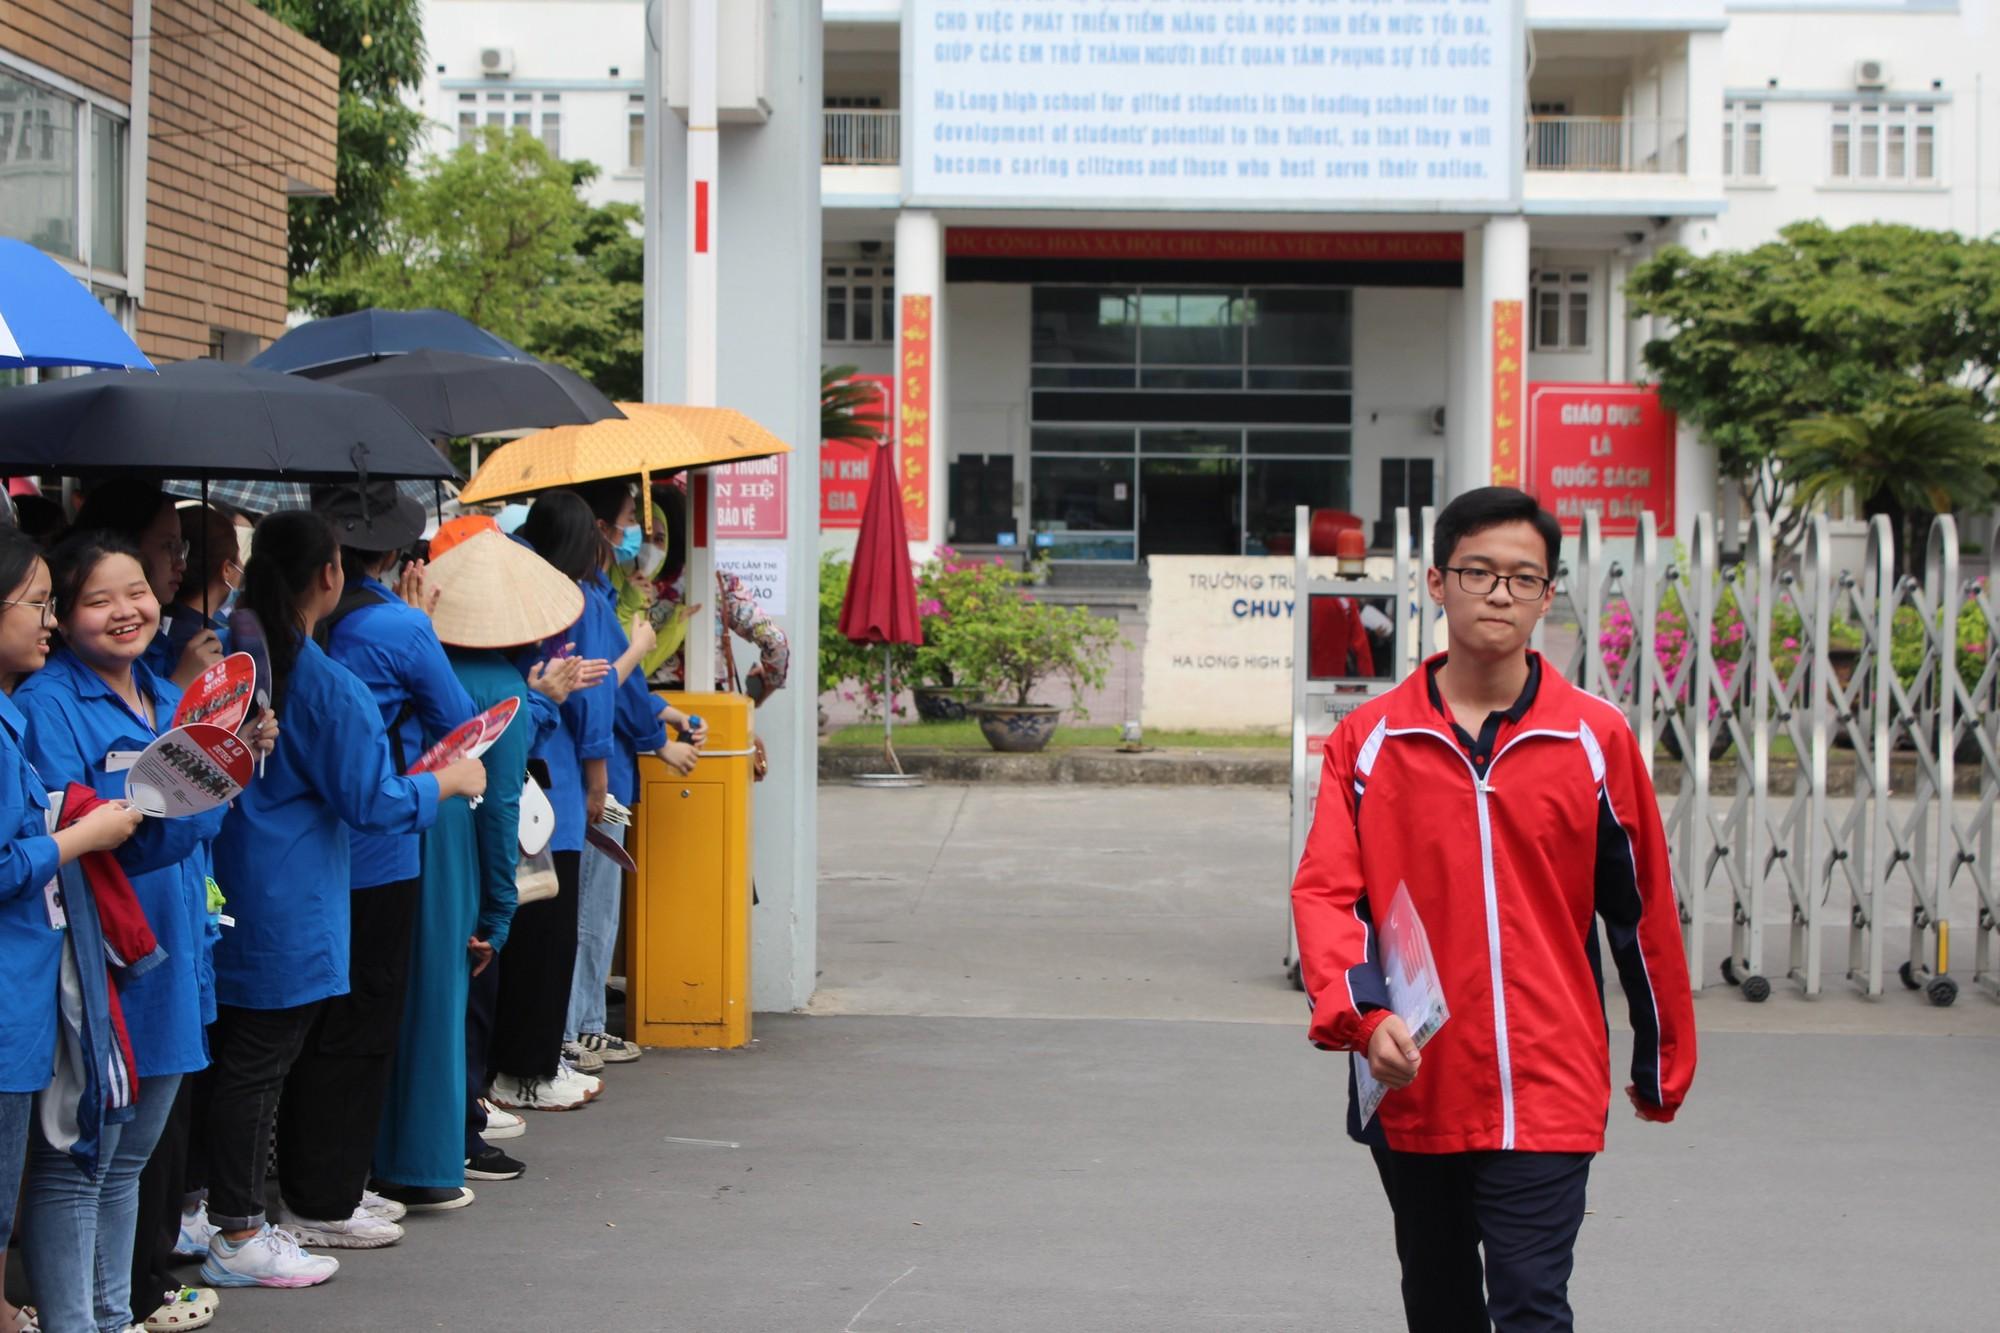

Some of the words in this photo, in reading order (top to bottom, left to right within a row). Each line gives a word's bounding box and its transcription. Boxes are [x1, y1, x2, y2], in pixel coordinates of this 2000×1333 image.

[935, 11, 968, 32] CHO
[976, 9, 1014, 33] VIỆC
[1022, 9, 1064, 32] PHÁT
[1264, 14, 1298, 36] HỌC
[1303, 14, 1341, 33] SINH
[934, 42, 974, 64] GIÚP
[980, 42, 1012, 64] CÁC
[1019, 43, 1043, 64] EM
[1242, 46, 1286, 66] QUAN
[934, 90, 954, 111] Ha
[960, 91, 997, 113] Long
[1003, 90, 1037, 113] high
[1043, 90, 1096, 112] school
[1102, 91, 1124, 112] for
[1132, 92, 1181, 113] gifted
[1188, 92, 1258, 113] students
[1263, 93, 1278, 113] is
[1282, 92, 1307, 113] the
[1312, 93, 1369, 117] leading
[1376, 93, 1428, 114] school
[1432, 93, 1456, 114] for
[1463, 94, 1490, 114] the
[934, 123, 1043, 145] development
[1052, 123, 1068, 144] of
[1152, 124, 1225, 146] potential
[1231, 125, 1249, 144] to
[1254, 125, 1281, 145] the
[1287, 125, 1344, 147] fullest,
[1352, 128, 1369, 145] so
[1377, 126, 1410, 145] that
[1416, 126, 1450, 148] they
[1460, 127, 1491, 146] will
[933, 155, 1001, 174] become
[1011, 155, 1068, 177] caring
[1077, 155, 1144, 176] citizens
[1149, 156, 1177, 176] and
[1183, 156, 1228, 176] those
[1237, 158, 1269, 177] who
[1280, 158, 1315, 177] best
[1326, 160, 1369, 178] serve
[1378, 158, 1418, 178] their
[1427, 159, 1488, 178] nation.
[1561, 400, 1603, 425] GIÁO
[1607, 404, 1642, 427] DỤC
[840, 456, 870, 480] KHÍ
[1552, 462, 1598, 488] QUỐC
[1603, 464, 1651, 487] SÁCH
[741, 479, 775, 500] HỆ
[827, 491, 857, 511] GIA
[717, 500, 739, 526] BẢO
[742, 503, 756, 530] VỆ
[750, 586, 772, 599] ÀO
[1189, 571, 1264, 590] TRƯỜNG
[1173, 655, 1193, 668] HA
[1197, 655, 1240, 669] LONG
[1244, 655, 1280, 669] HIGH
